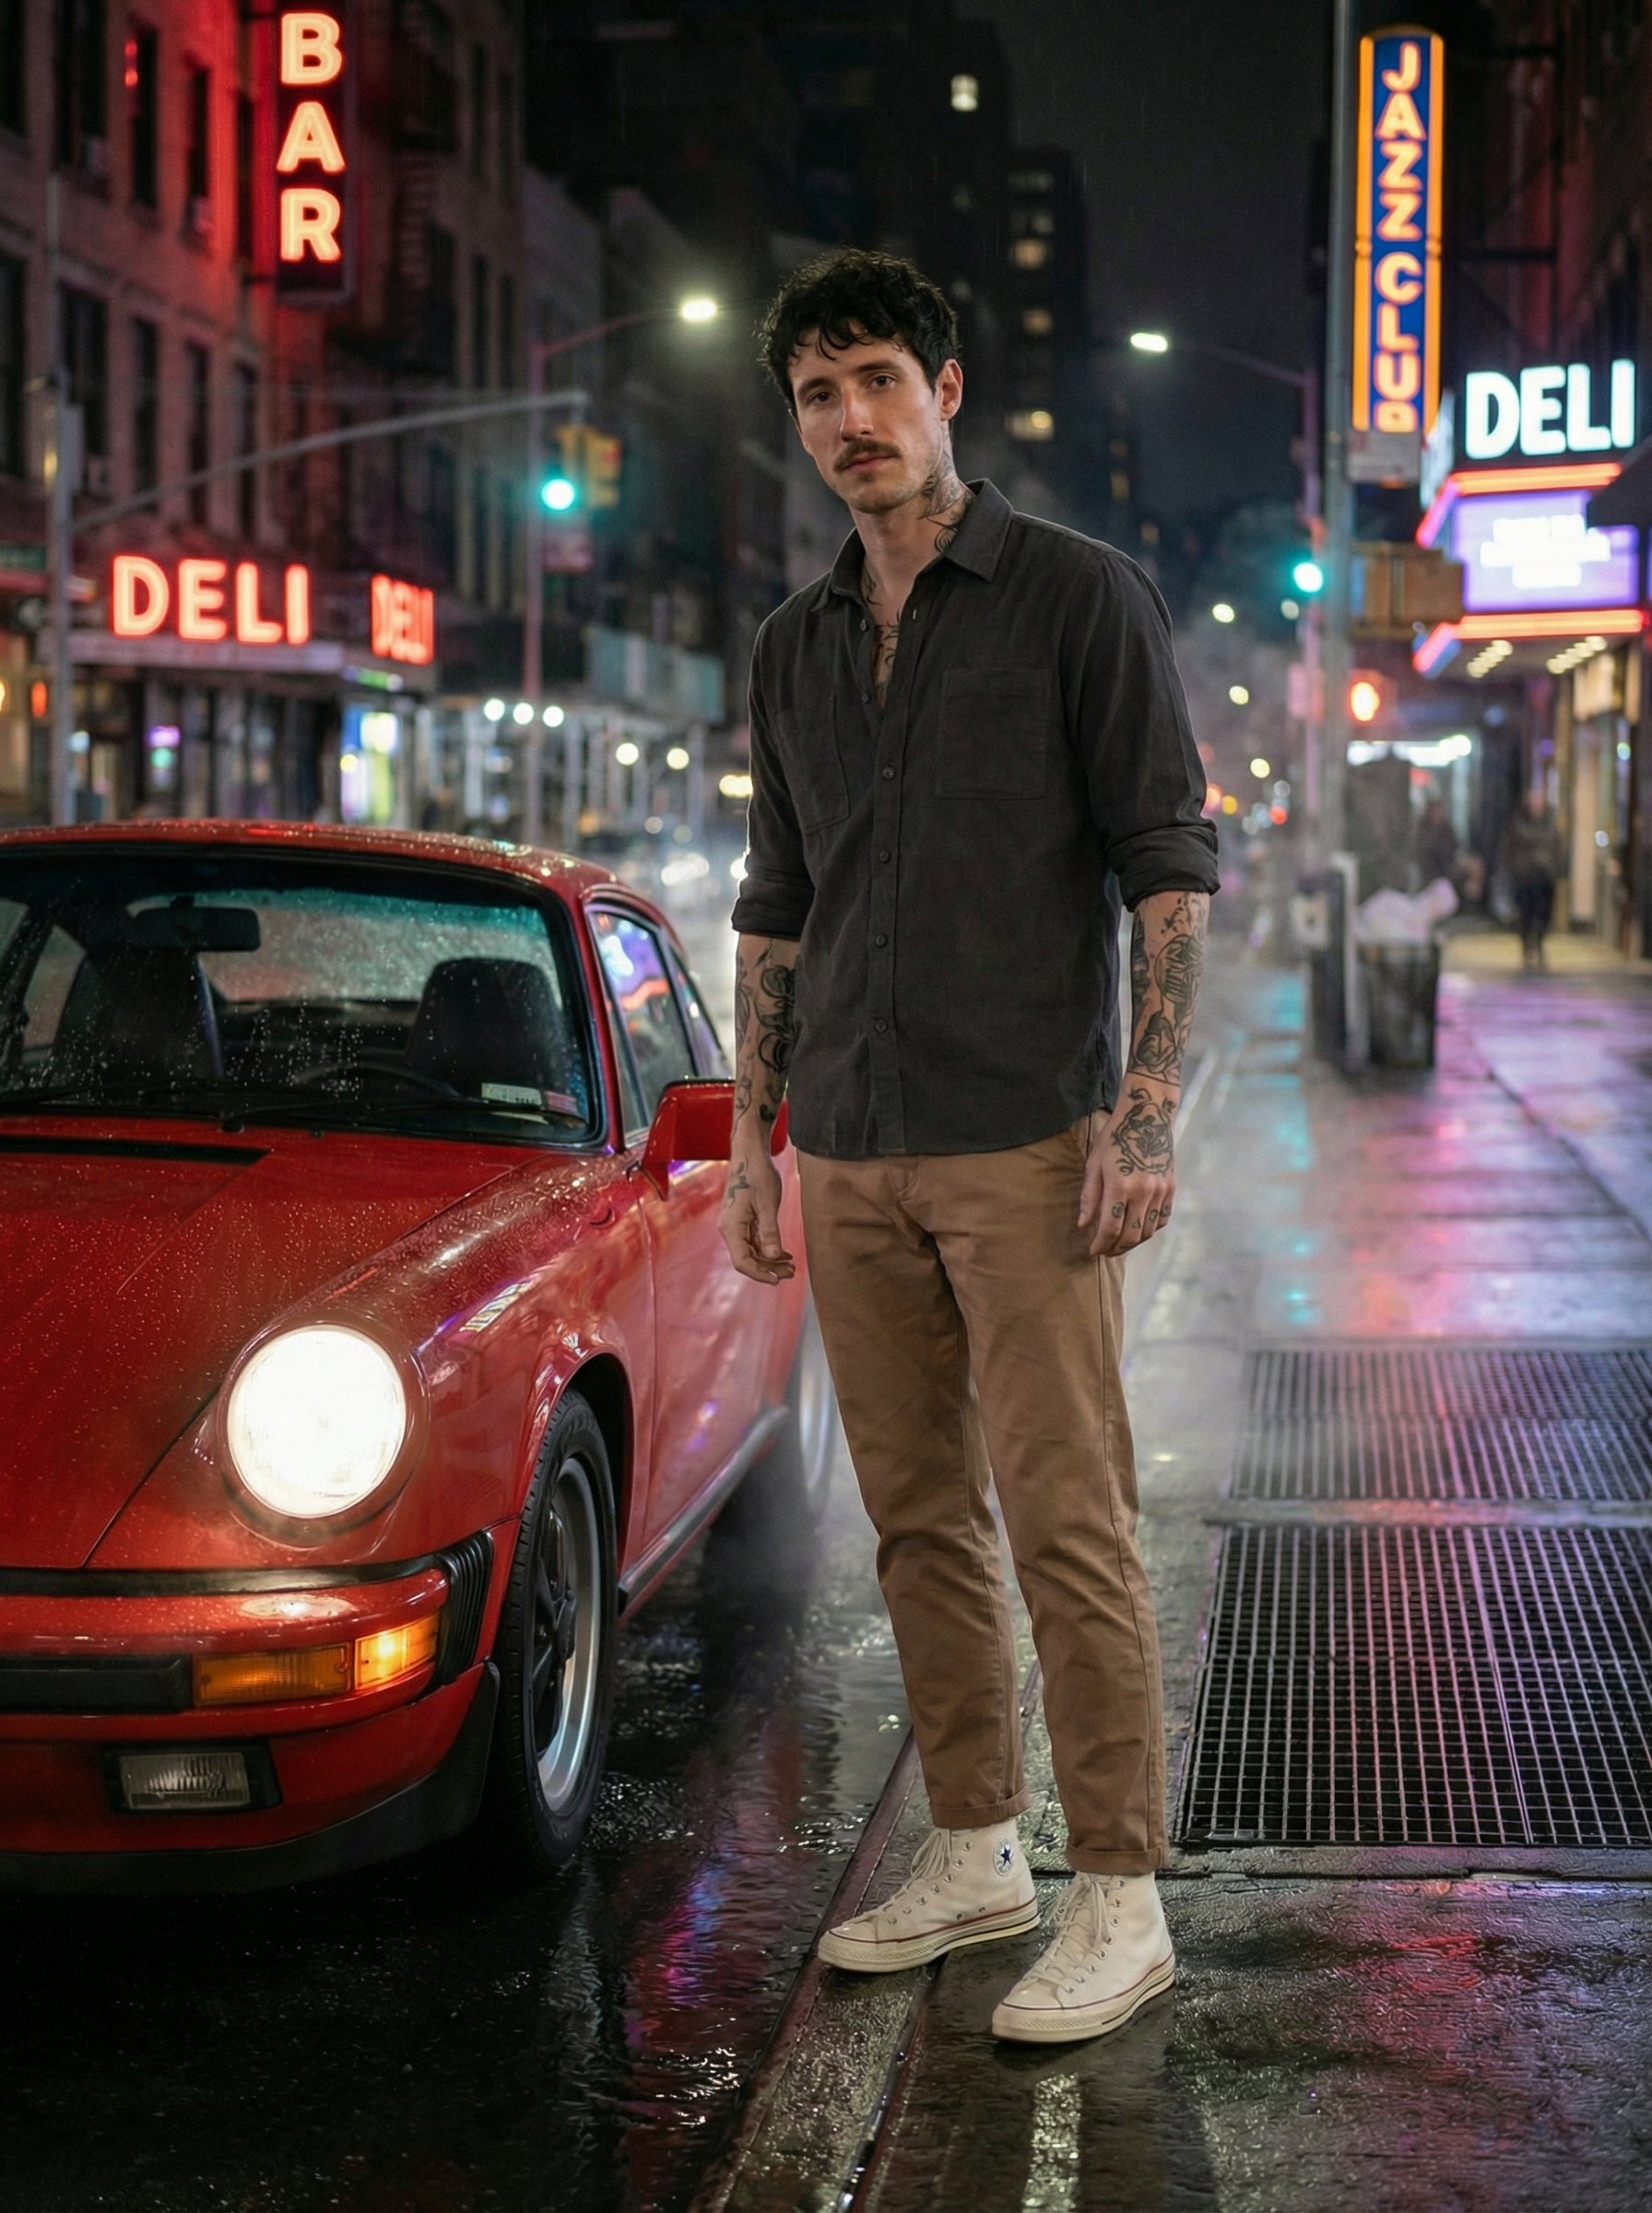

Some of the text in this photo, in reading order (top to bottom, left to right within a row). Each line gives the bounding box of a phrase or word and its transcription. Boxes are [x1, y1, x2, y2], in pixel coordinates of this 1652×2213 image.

[278, 12, 345, 263] BAR
[1375, 41, 1427, 242] JAZZ
[1466, 359, 1635, 459] DELI
[112, 554, 311, 645] DELI
[371, 573, 434, 665] DELI
